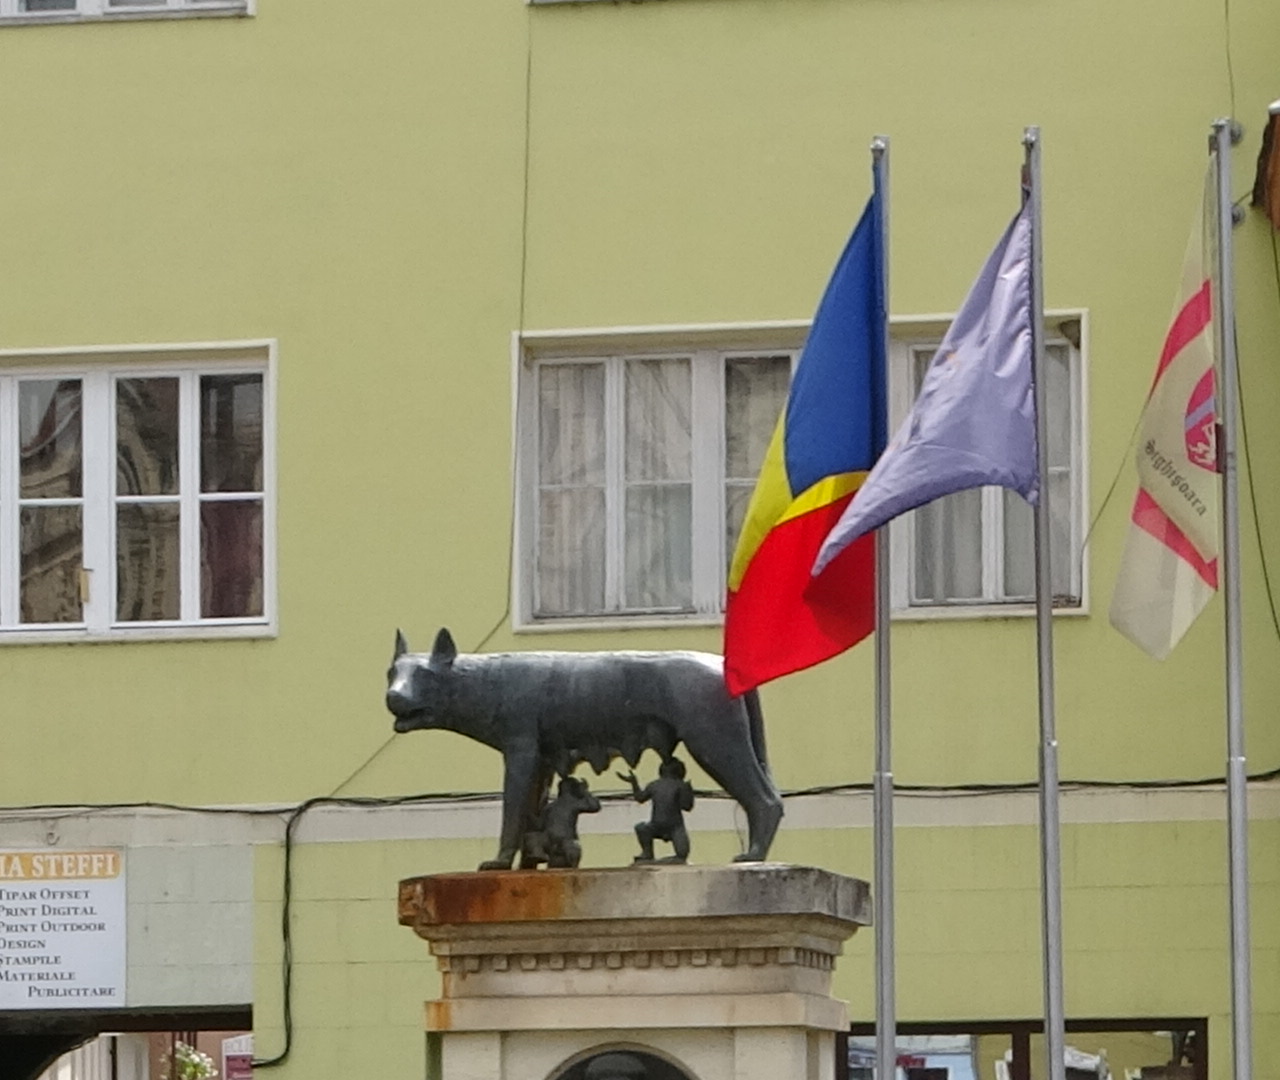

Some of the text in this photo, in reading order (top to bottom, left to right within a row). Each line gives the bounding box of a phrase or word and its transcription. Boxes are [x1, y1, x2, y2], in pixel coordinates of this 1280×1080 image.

[32, 853, 115, 877] STEFFI
[40, 888, 90, 899] OFFSET
[41, 904, 98, 916] DIGITAL
[41, 920, 106, 932] OUTDOOR
[28, 986, 115, 997] PUBLICITARE
